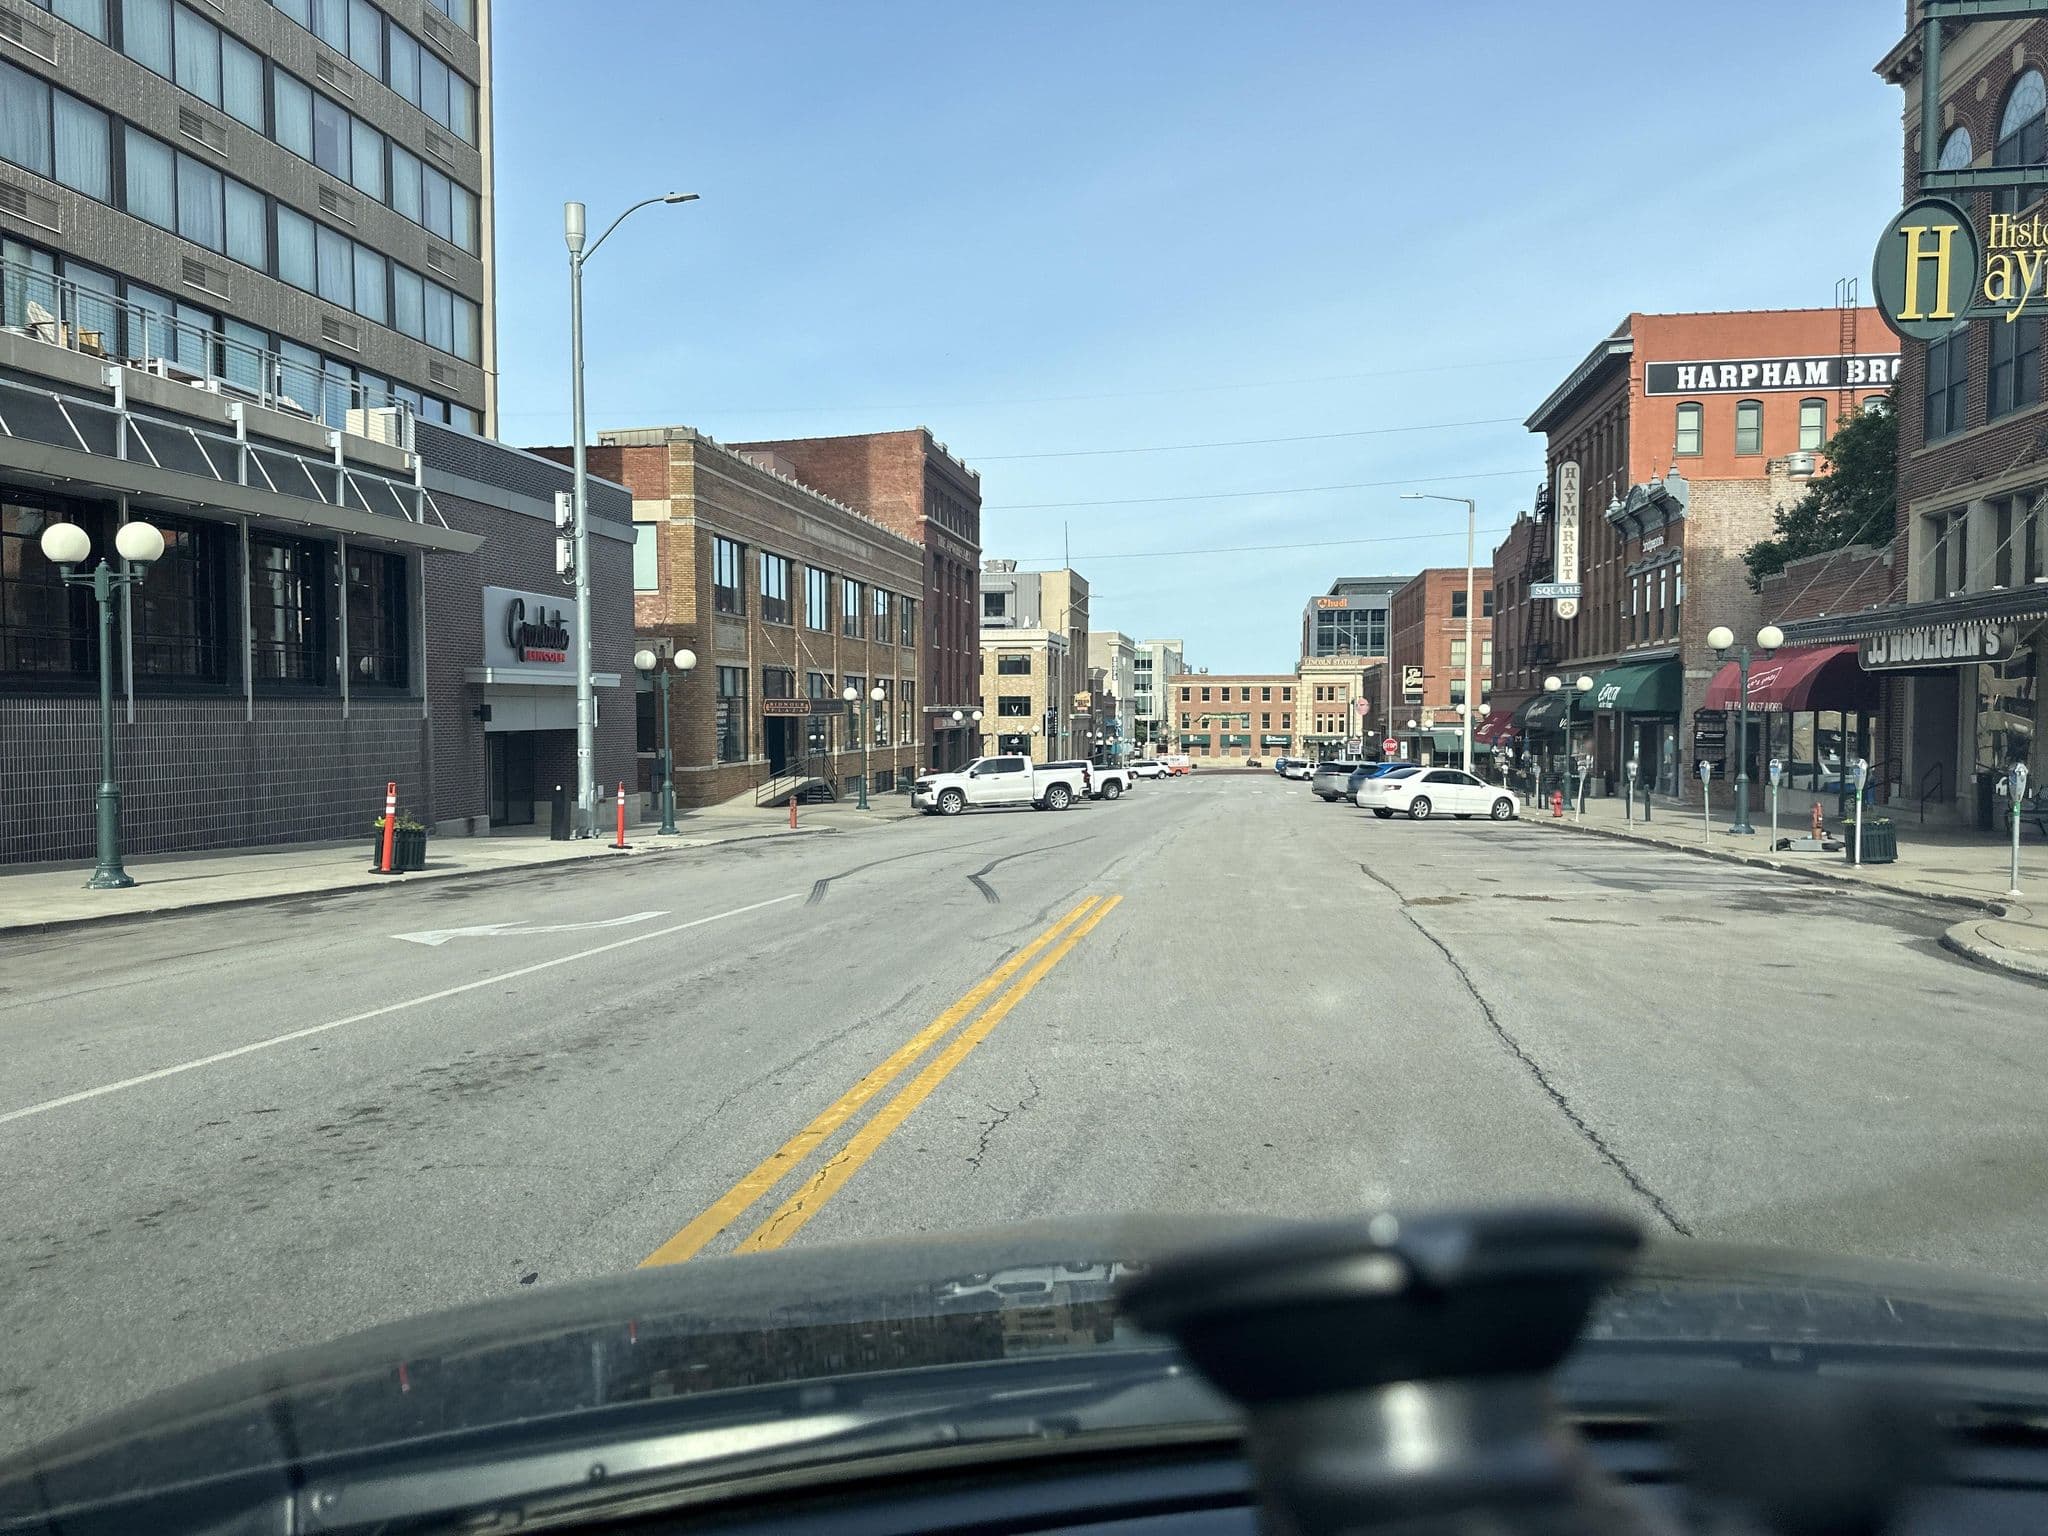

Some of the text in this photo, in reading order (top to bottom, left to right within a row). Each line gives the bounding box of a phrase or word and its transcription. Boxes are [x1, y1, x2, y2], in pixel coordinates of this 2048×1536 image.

[1677, 360, 1829, 390] HARPHAM
[1562, 467, 1577, 580] HAYMARKET
[1327, 598, 1348, 607] hudl
[1535, 586, 1582, 595] SQUARE
[1867, 622, 2001, 664] JJ HOOLIGAN'S
